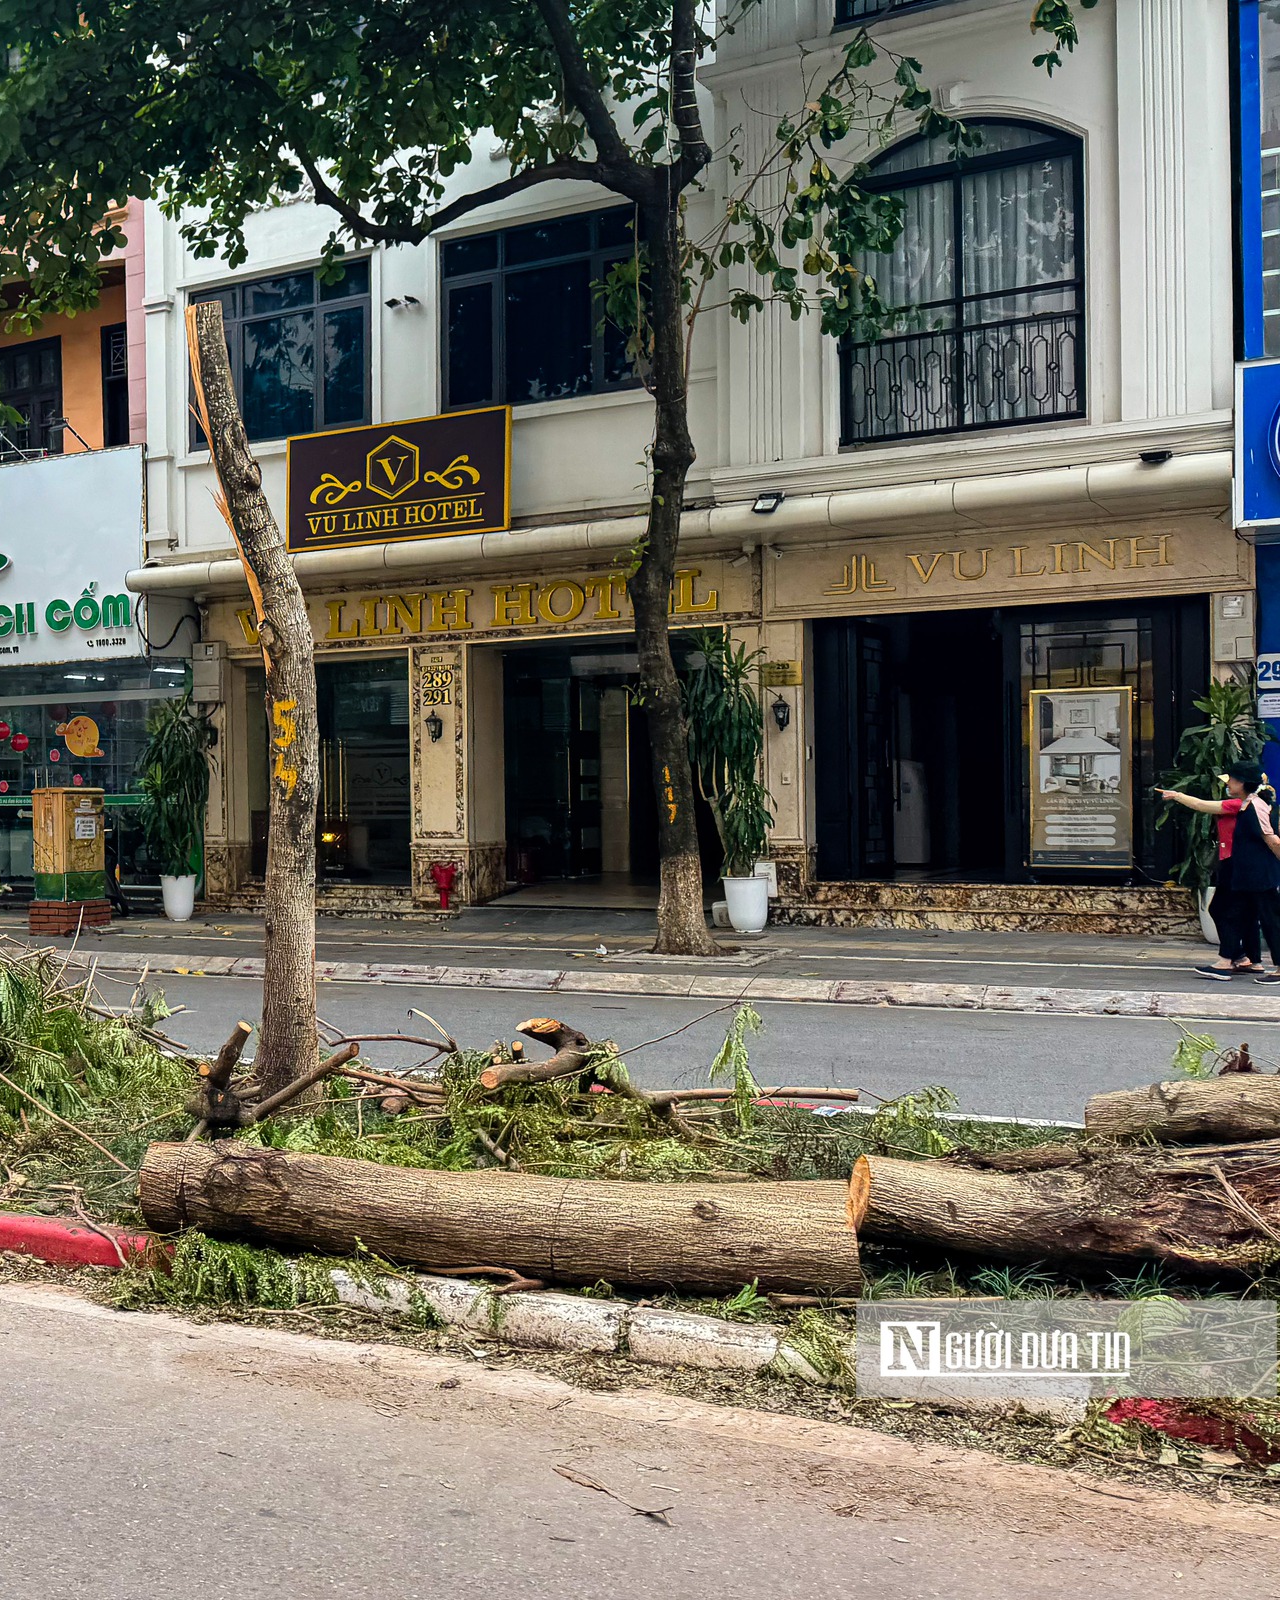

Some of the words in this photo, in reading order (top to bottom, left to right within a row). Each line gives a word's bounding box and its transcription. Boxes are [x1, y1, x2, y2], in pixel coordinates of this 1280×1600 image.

[376, 455, 409, 486] V
[307, 514, 338, 535] VU
[342, 508, 398, 532] LINH
[403, 498, 483, 528] HOTEL
[905, 547, 992, 584] VU
[1008, 533, 1174, 578] LINH
[324, 587, 474, 640] LINH
[422, 669, 453, 689] 289
[423, 687, 452, 706] 291
